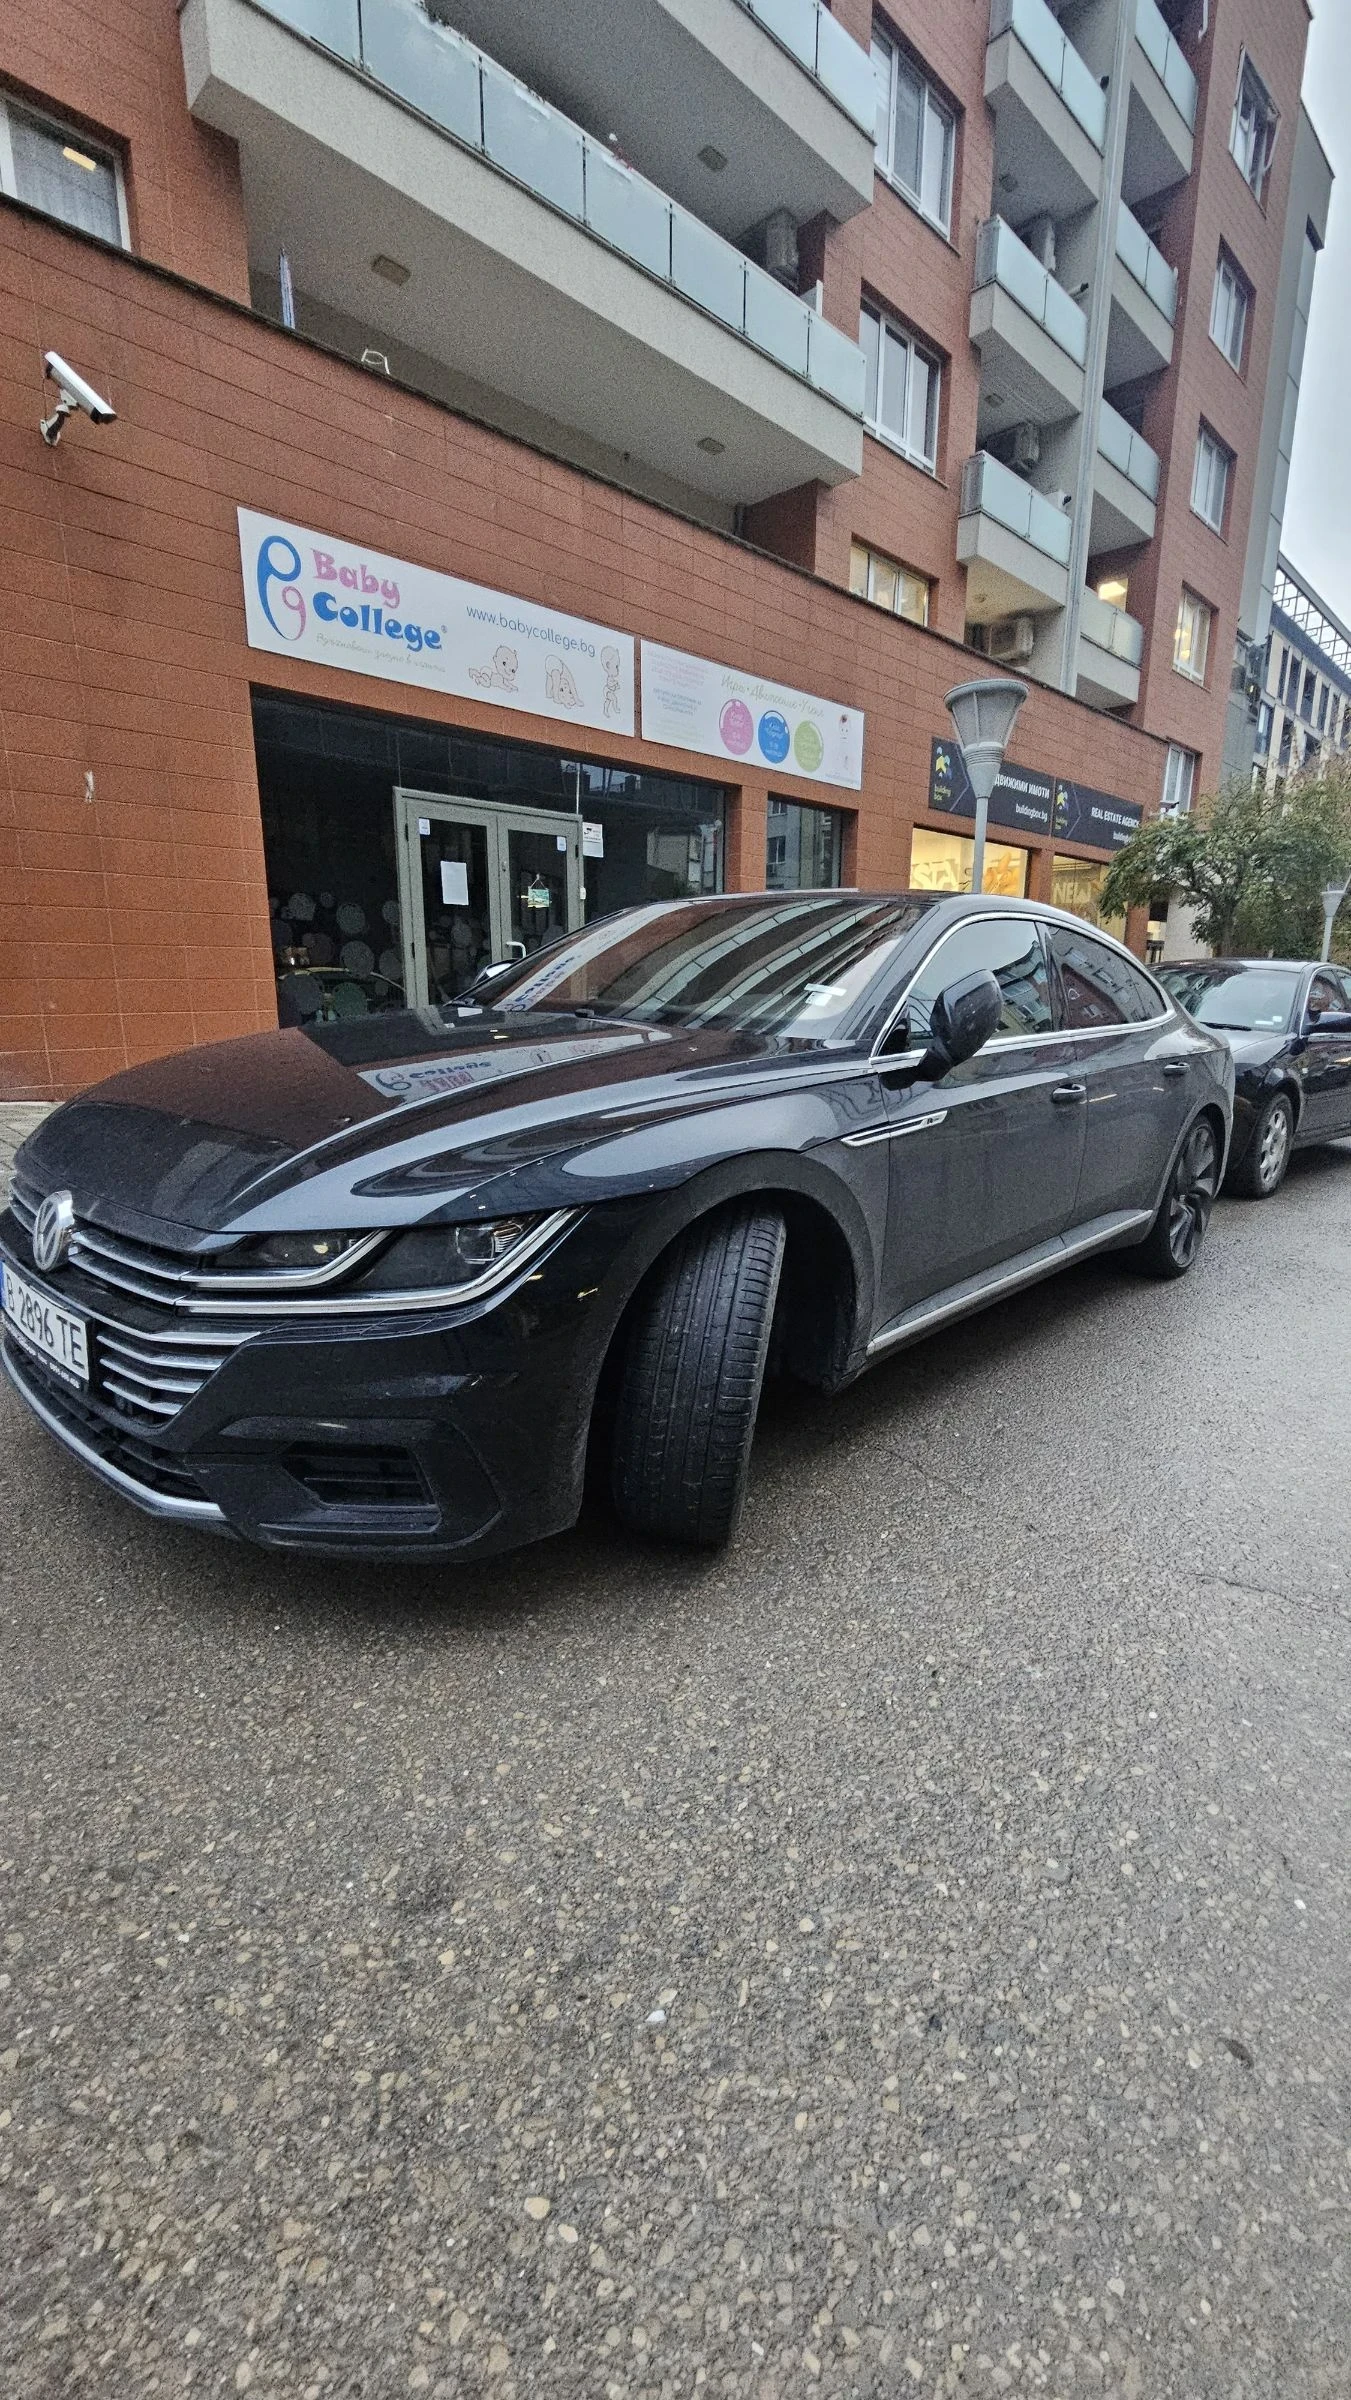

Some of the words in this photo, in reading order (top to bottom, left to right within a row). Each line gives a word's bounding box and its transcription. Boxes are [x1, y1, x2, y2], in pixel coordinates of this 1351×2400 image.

[311, 548, 400, 609] Baby
[466, 605, 596, 658] www.babycollege.bg
[994, 774, 1028, 793] ДВИЖИМИ
[1091, 806, 1104, 820] REAL
[1104, 810, 1122, 825] ESTATE
[6, 1272, 15, 1313] B
[18, 1285, 55, 1348] 2896
[56, 1313, 86, 1371] TE
